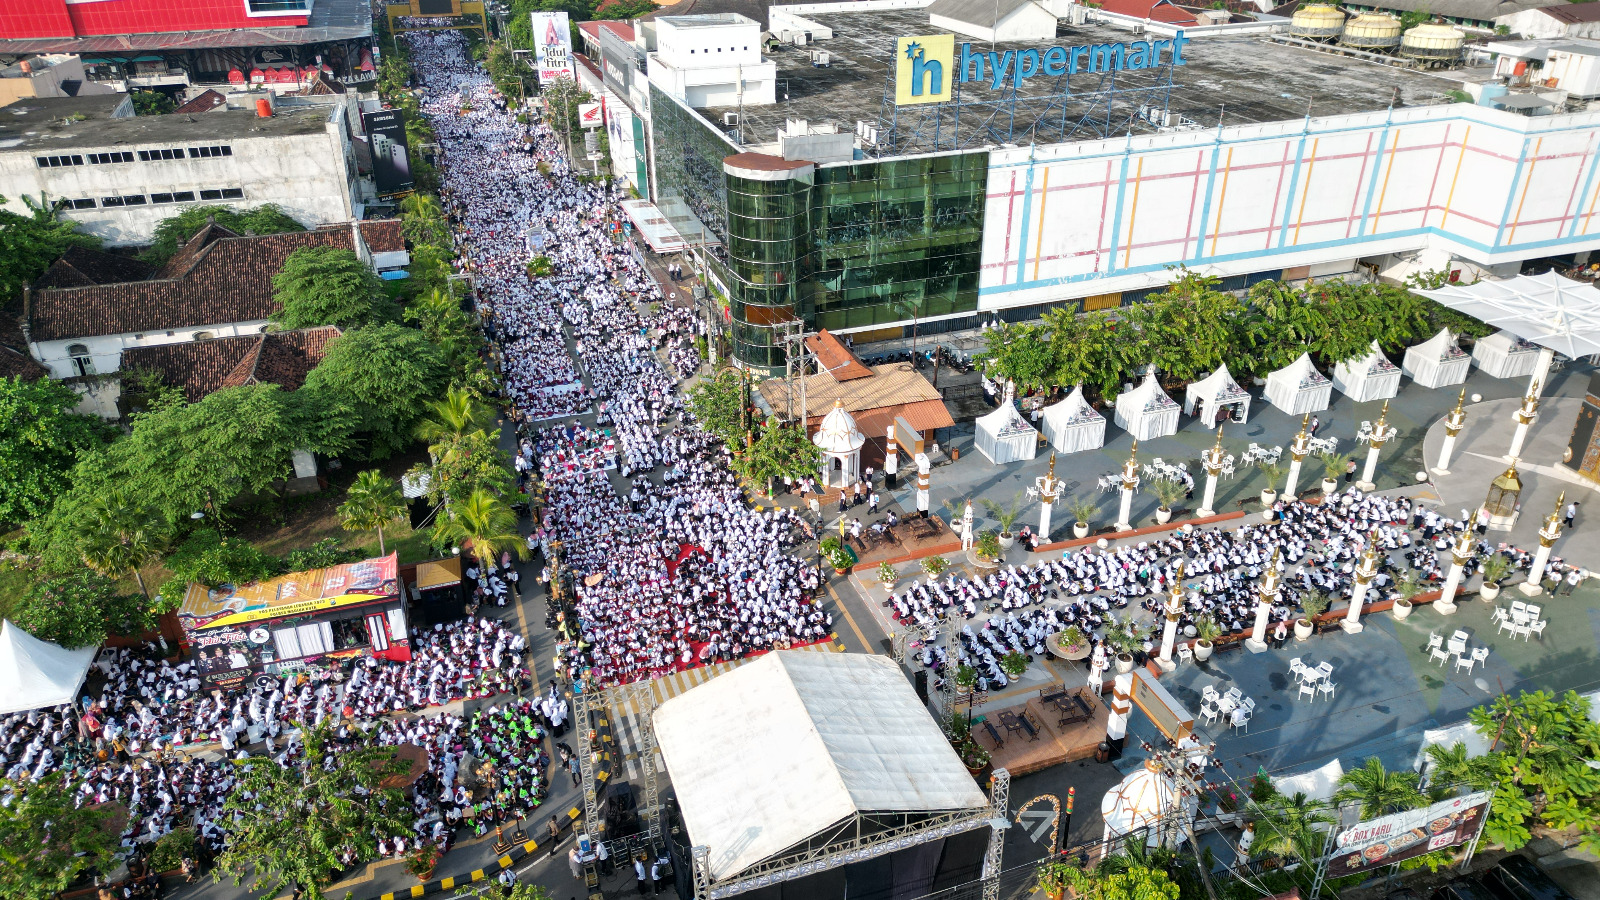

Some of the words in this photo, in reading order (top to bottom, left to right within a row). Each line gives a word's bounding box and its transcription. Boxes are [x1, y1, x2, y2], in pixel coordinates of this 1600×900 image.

[541, 46, 567, 57] Idul
[543, 57, 568, 68] Fitri
[958, 29, 1190, 91] hypermart
[1353, 830, 1370, 842] BOX
[1371, 823, 1393, 836] BARU
